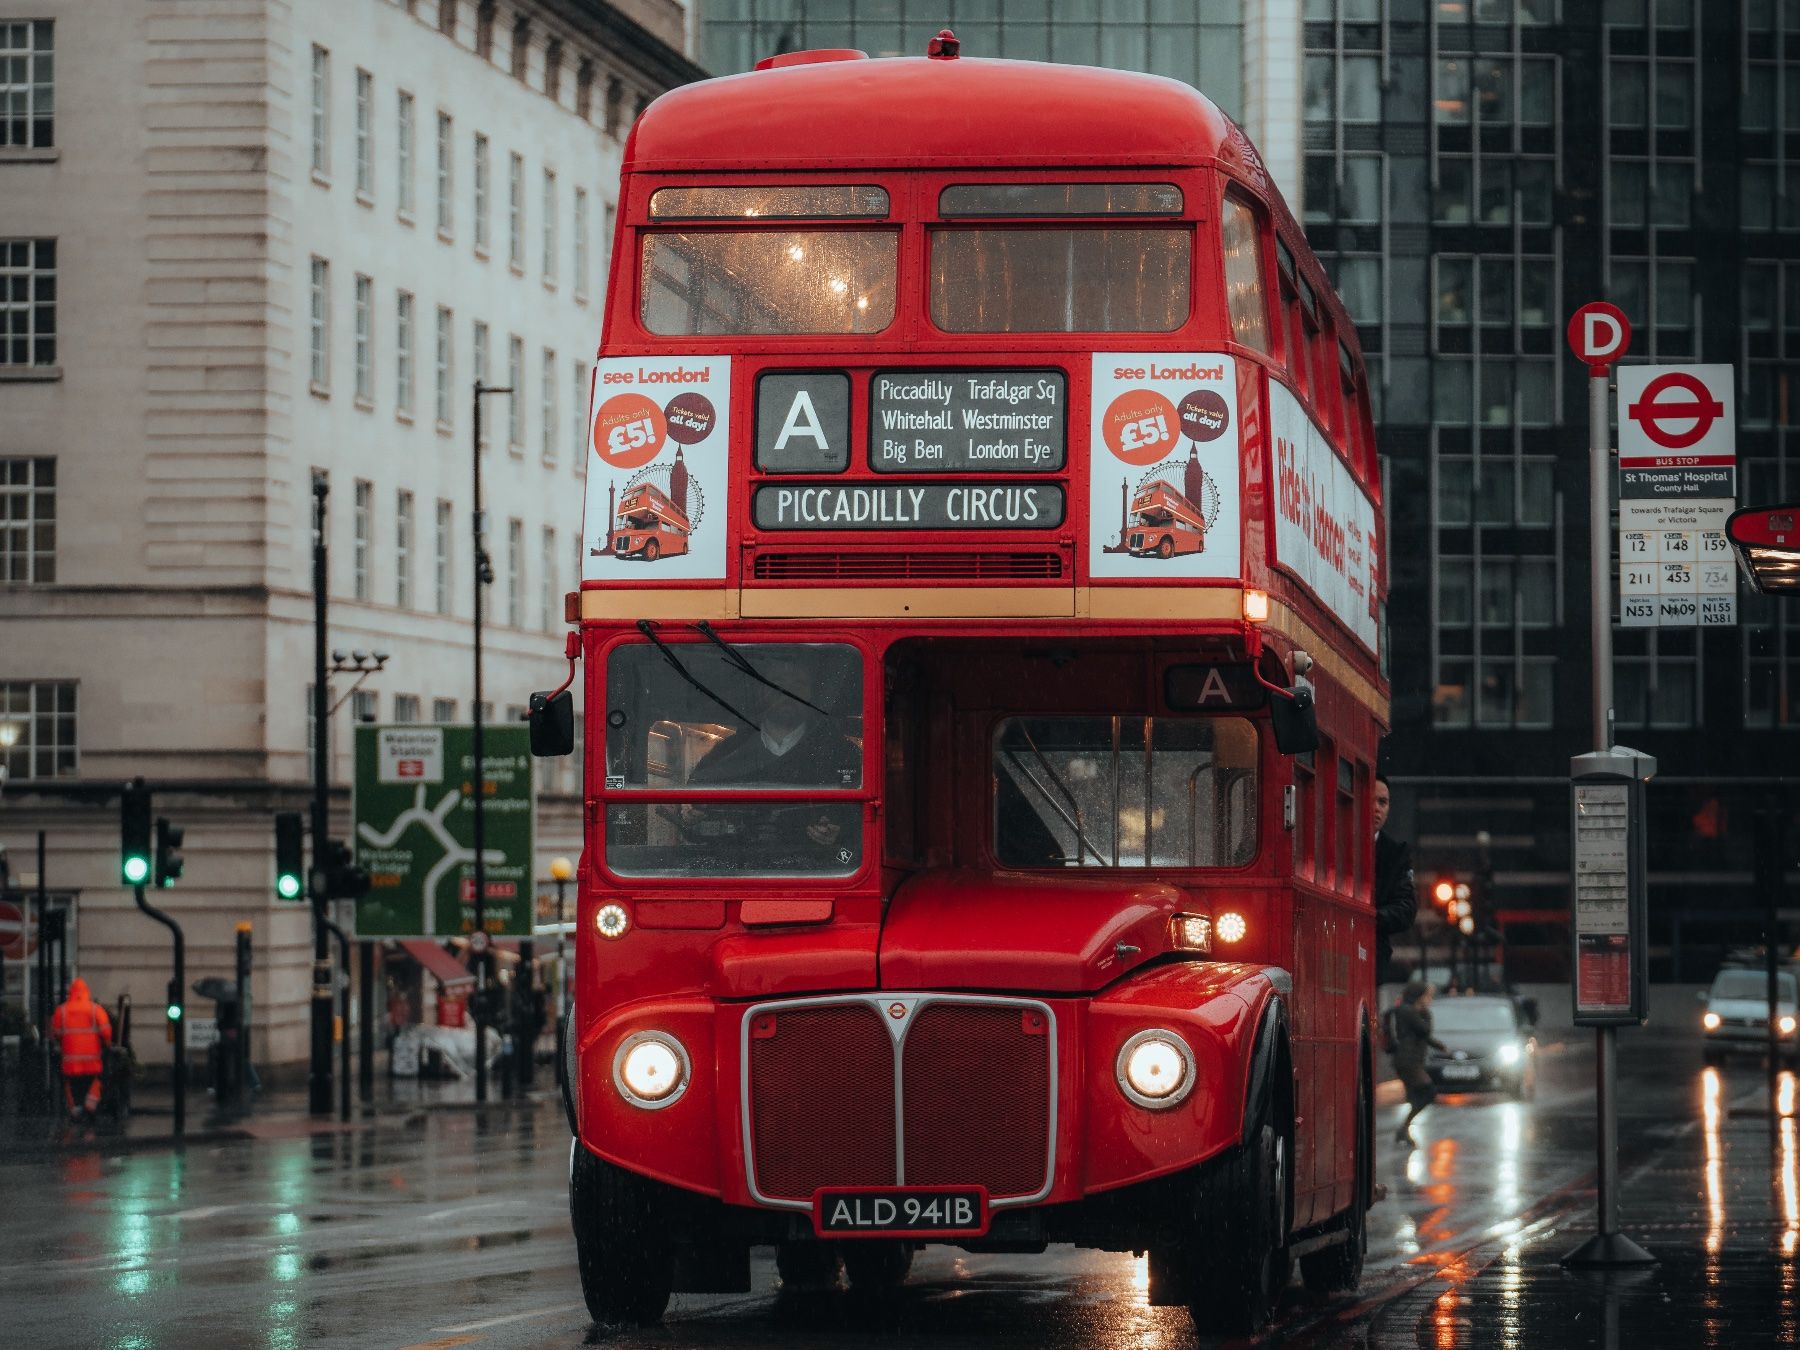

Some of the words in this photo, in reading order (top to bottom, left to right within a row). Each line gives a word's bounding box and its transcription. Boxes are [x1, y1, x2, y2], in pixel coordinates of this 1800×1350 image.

[1584, 313, 1622, 356] D
[603, 372, 634, 384] see
[638, 366, 710, 384] London!
[1113, 367, 1146, 380] see
[1150, 362, 1224, 380] London!
[880, 379, 953, 405] Piccadilly
[967, 379, 1033, 405] Trafalgar
[1036, 379, 1056, 405] Sq
[602, 413, 630, 427] Adults
[631, 407, 651, 419] only
[673, 406, 694, 417] Tickets
[694, 413, 710, 421] valid
[774, 390, 830, 450] A
[882, 410, 954, 430] Whitehall
[962, 408, 1053, 430] Westminster
[1113, 412, 1143, 423] Adults
[1144, 404, 1163, 415] only
[1186, 403, 1208, 415] Tickets
[1208, 410, 1224, 419] valid
[669, 414, 684, 425] all
[685, 418, 707, 432] day!
[1183, 412, 1197, 423] all
[1199, 415, 1222, 430] day!
[607, 417, 656, 455] £5!
[1120, 415, 1170, 452] £5!
[883, 440, 907, 463] Big
[915, 440, 943, 459] Ben
[968, 439, 1019, 459] London
[1024, 439, 1051, 463] Eye
[1676, 457, 1700, 465] STOP
[1625, 473, 1637, 482] St
[1639, 473, 1682, 482] Thomas'
[1684, 472, 1728, 483] Hospital
[1654, 484, 1682, 493] County
[778, 488, 925, 522] PICCADILLY
[946, 487, 1038, 521] CIRCUS
[1663, 506, 1696, 515] Trafalgar
[1698, 506, 1724, 515] Square
[1632, 541, 1646, 552] 12
[1666, 540, 1689, 551] 148
[1704, 540, 1727, 551] 159
[1629, 573, 1651, 584] 211
[1666, 572, 1691, 583] 453
[1704, 572, 1729, 583] 734
[1626, 606, 1653, 617] N53
[1702, 603, 1731, 613] N155
[1704, 614, 1731, 623] N381
[1197, 667, 1232, 704] A
[830, 1198, 897, 1225] ALD
[903, 1197, 973, 1225] 941B
